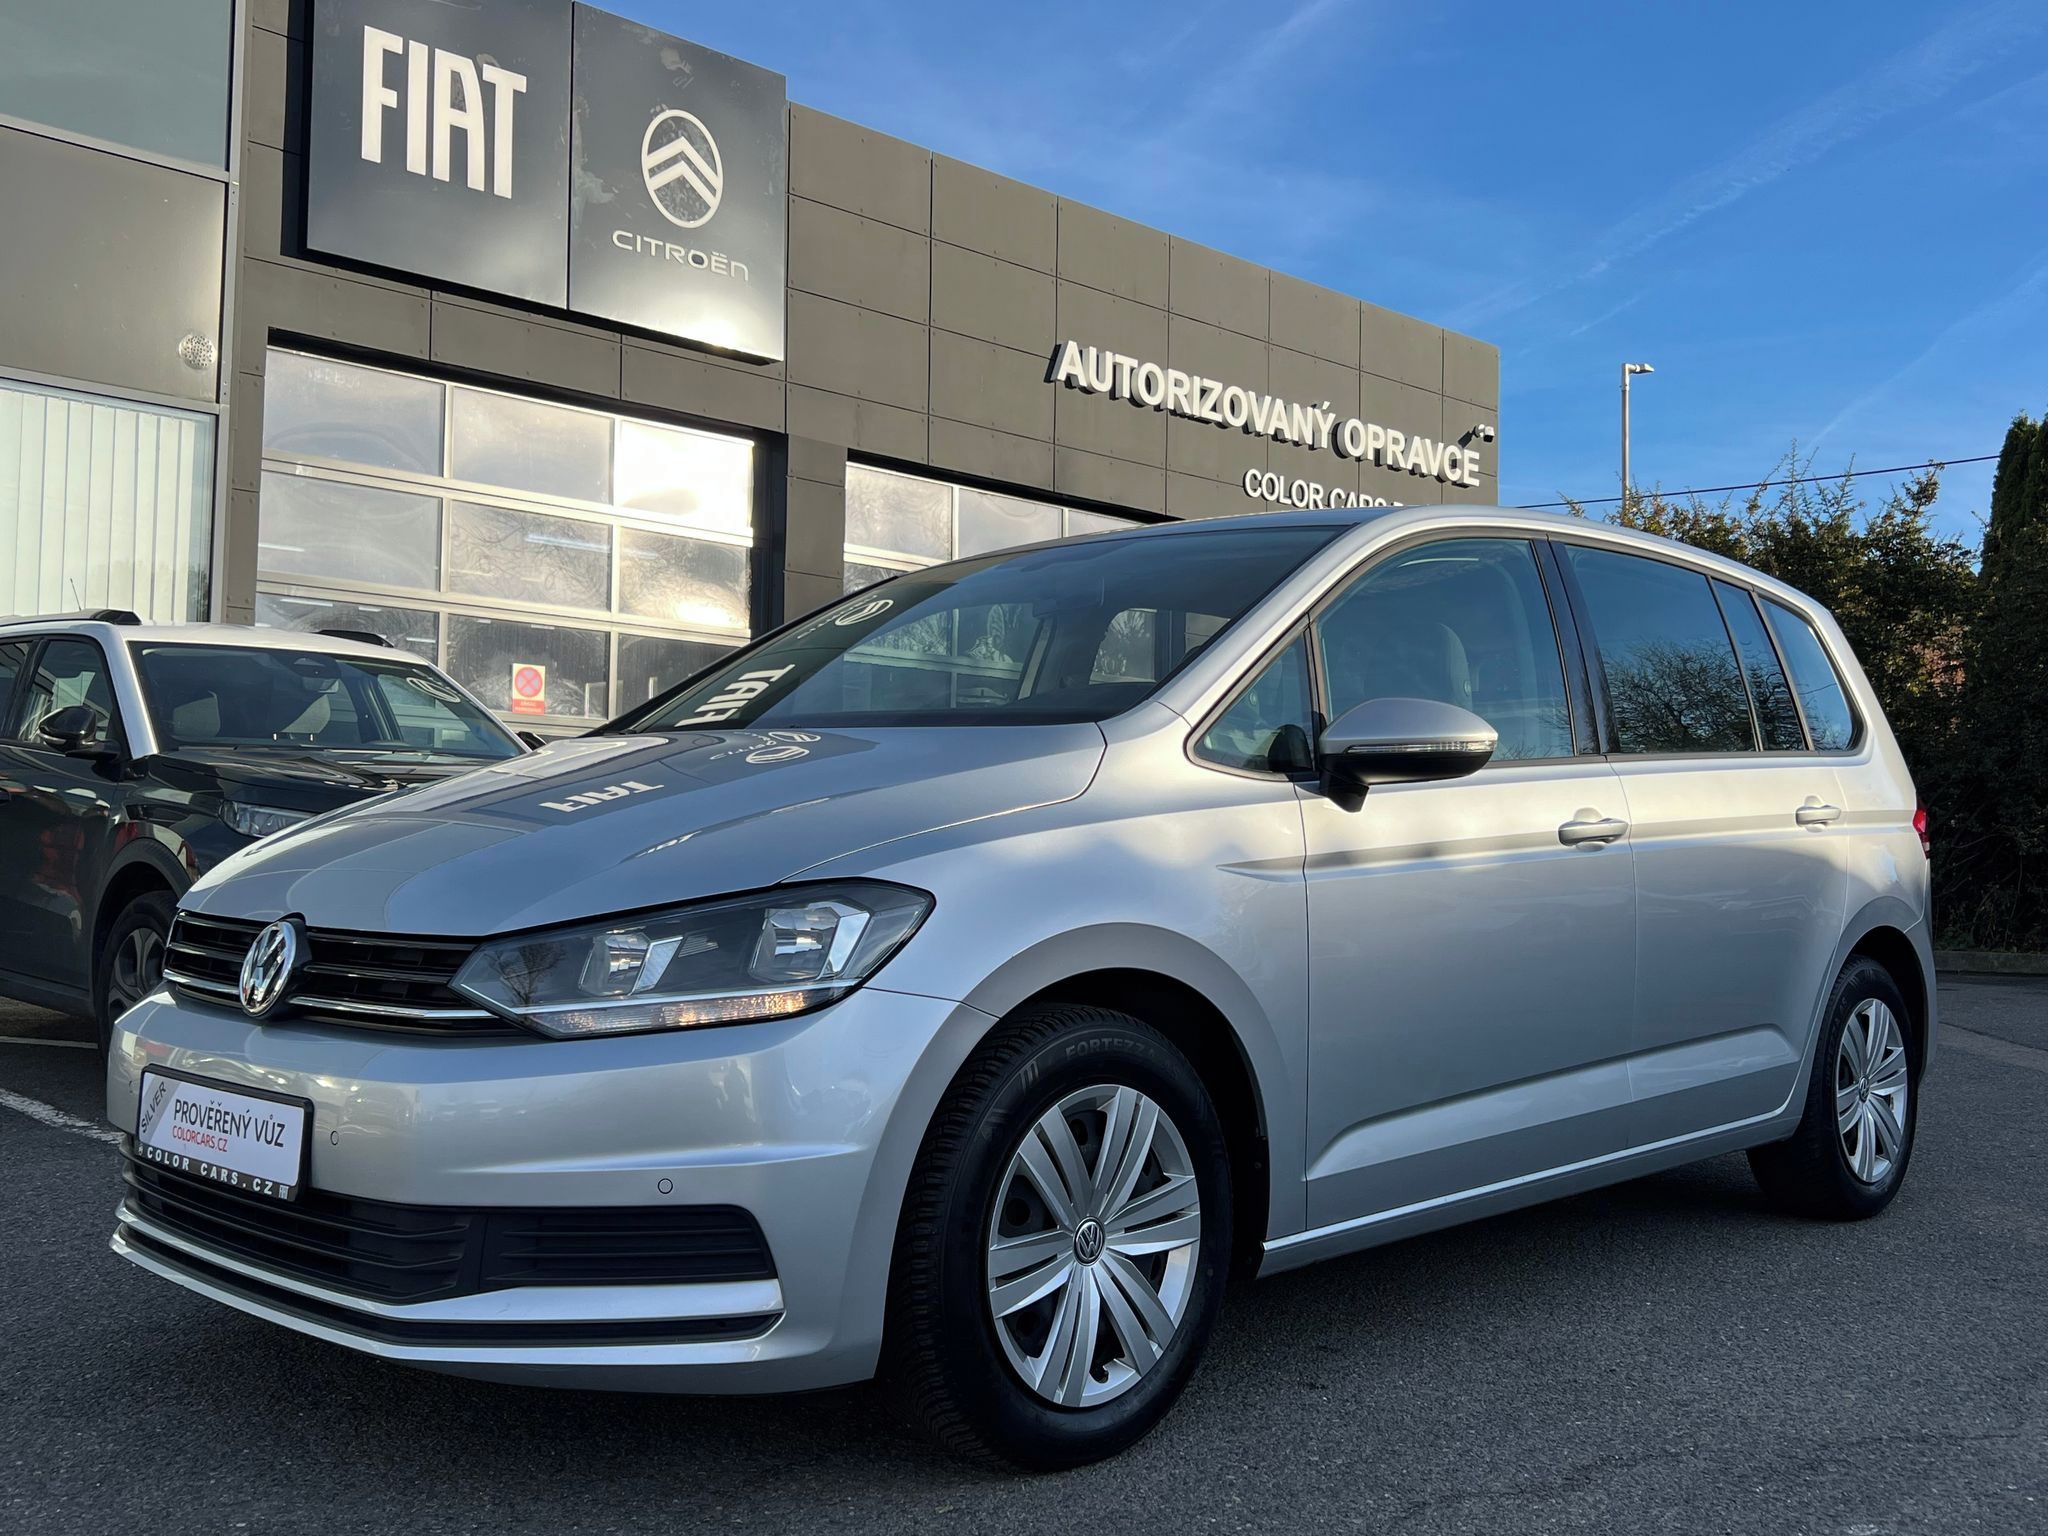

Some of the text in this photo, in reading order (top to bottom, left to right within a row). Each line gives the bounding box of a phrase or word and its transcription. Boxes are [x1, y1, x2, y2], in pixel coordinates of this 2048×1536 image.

[361, 26, 527, 199] FIAT
[1056, 340, 1481, 487] AUTORIZOVANÝ OPRAVCE
[1245, 469, 1324, 510] COLOR
[141, 1081, 167, 1134] SILVER
[173, 1098, 286, 1147] PROVĚŘENÝ VŮZ
[147, 1147, 189, 1171] COLOR
[172, 1125, 228, 1152] COLORCARS.CZ
